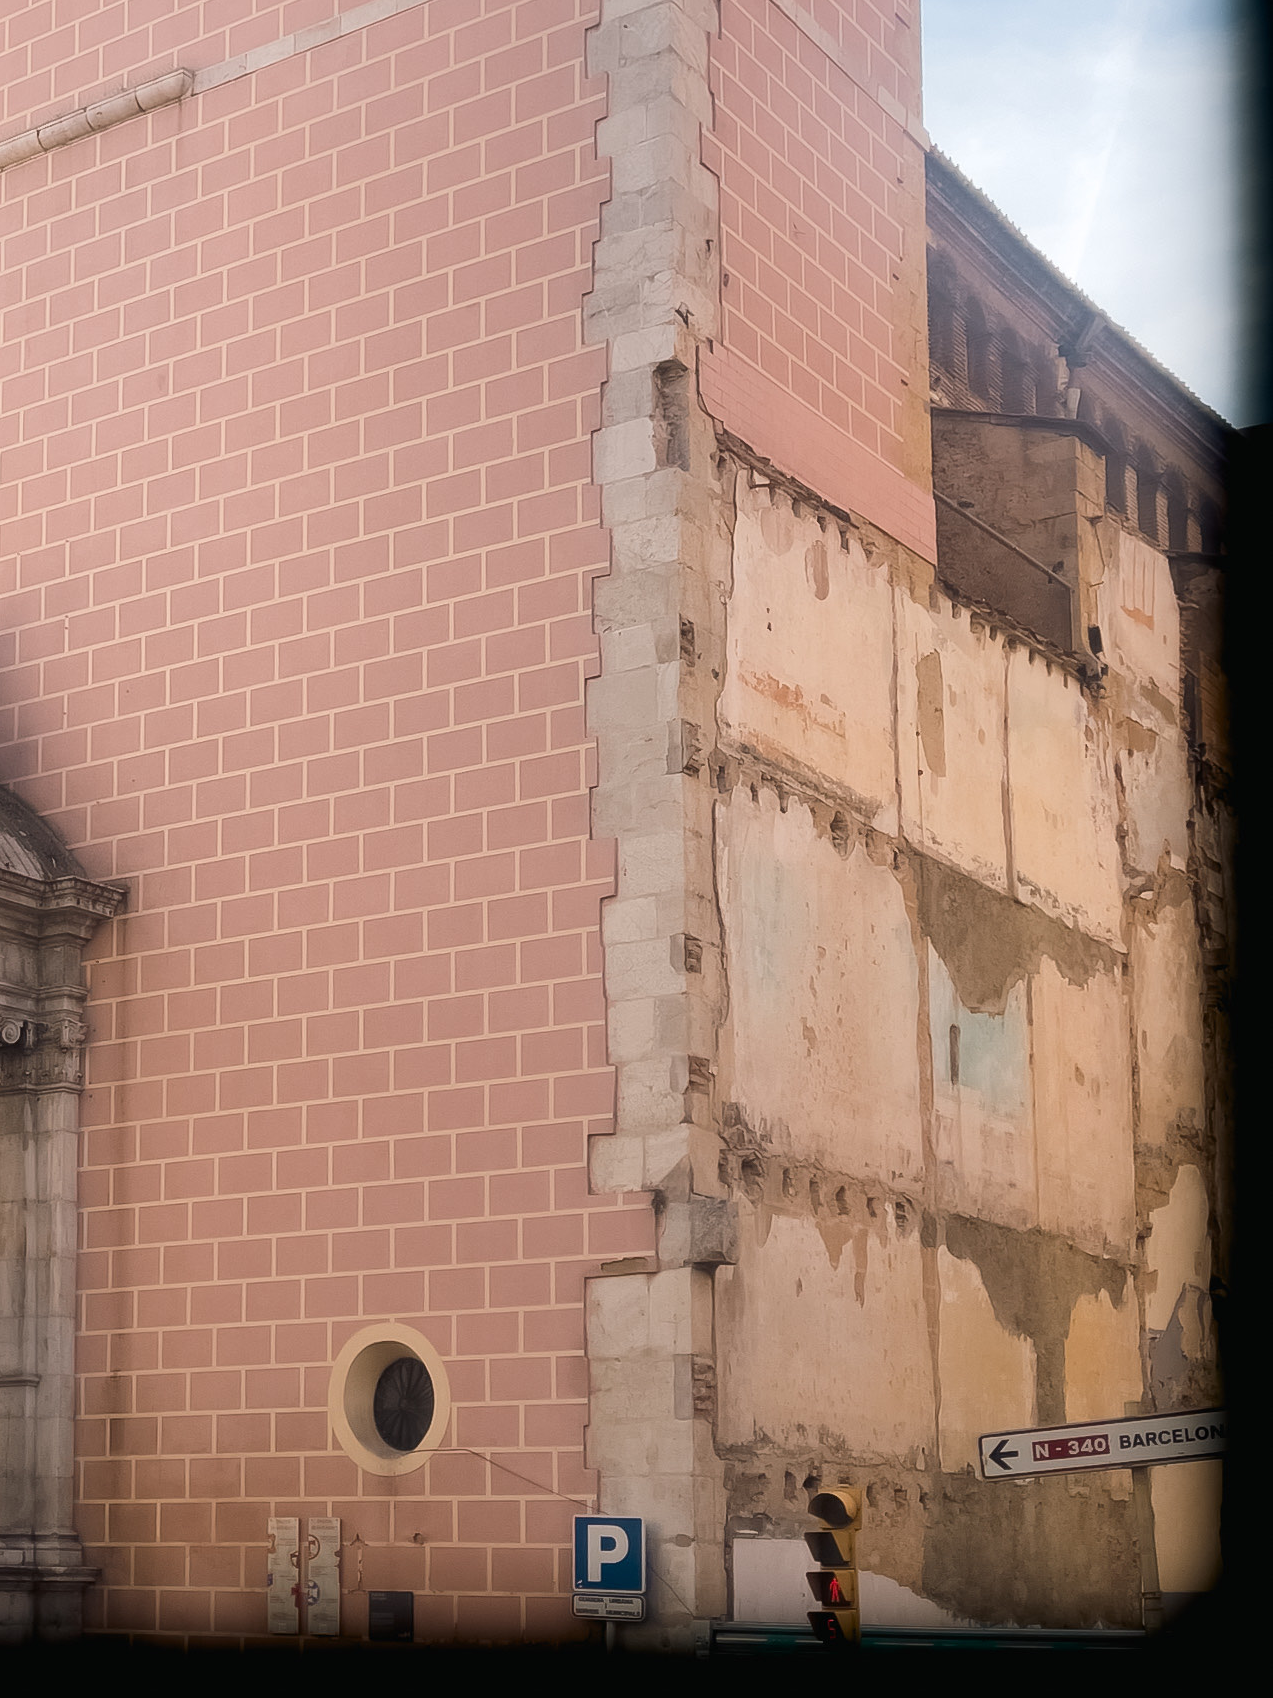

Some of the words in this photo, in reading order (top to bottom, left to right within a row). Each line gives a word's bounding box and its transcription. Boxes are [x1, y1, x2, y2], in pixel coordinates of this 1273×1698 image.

[1035, 1443, 1050, 1459] N
[1067, 1438, 1107, 1455] 340
[587, 1524, 629, 1582] P
